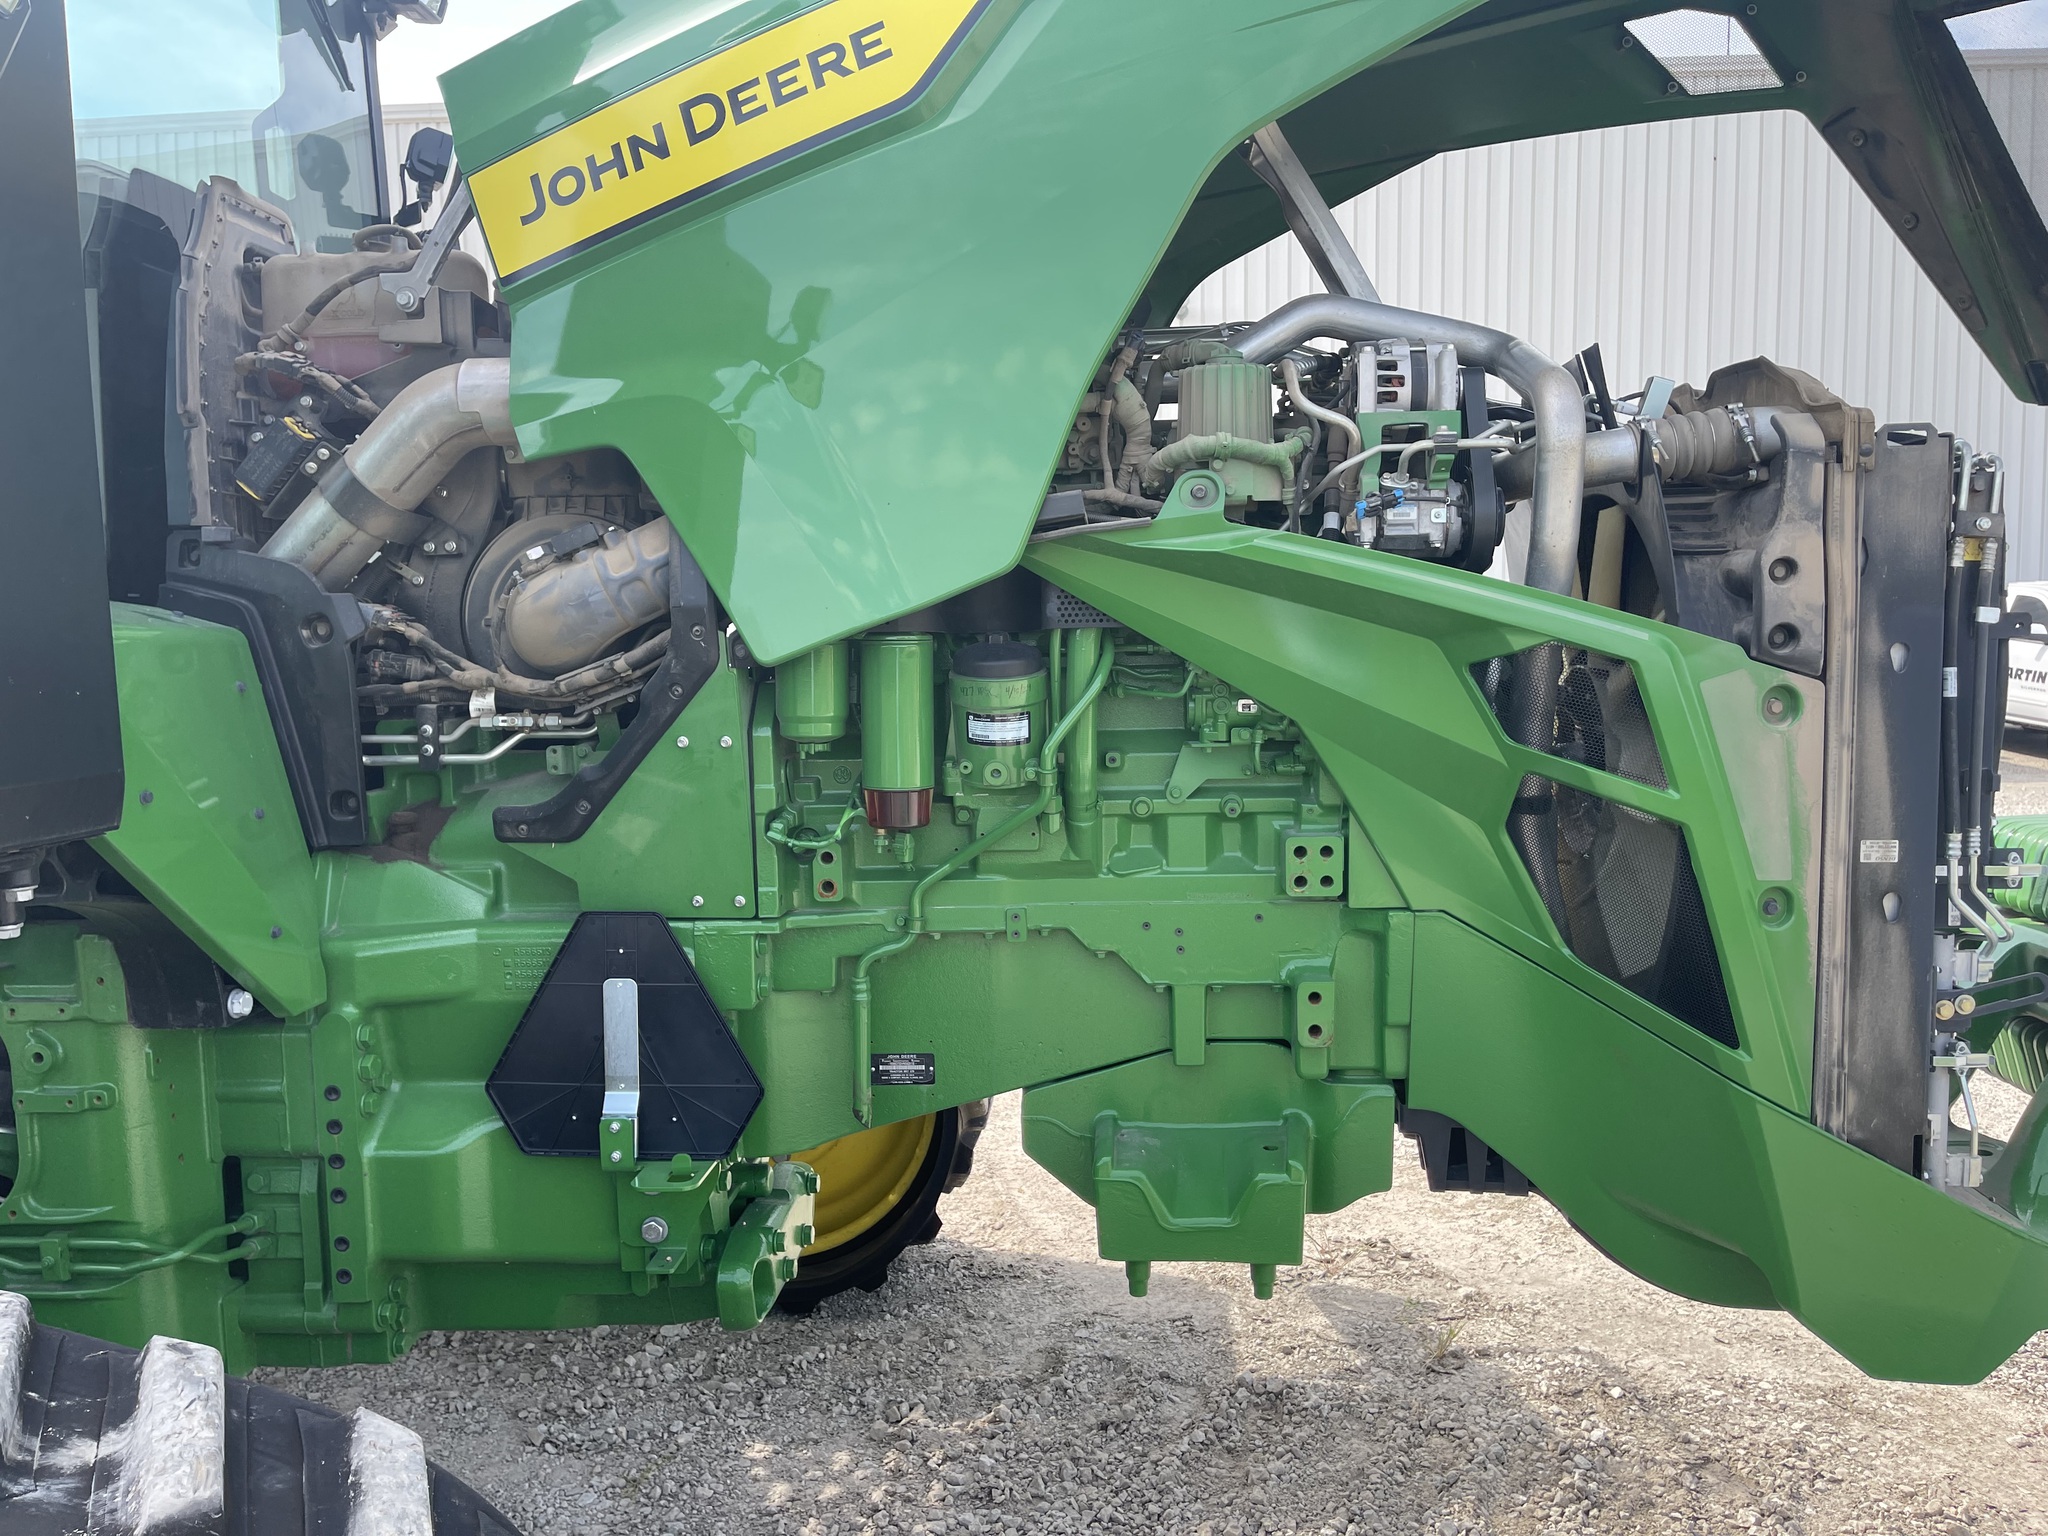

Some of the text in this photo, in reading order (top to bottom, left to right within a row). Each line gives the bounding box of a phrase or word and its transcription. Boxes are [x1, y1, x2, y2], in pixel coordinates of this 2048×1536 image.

[519, 20, 893, 226] JOHN DEERE
[2008, 666, 2048, 684] ARTIN
